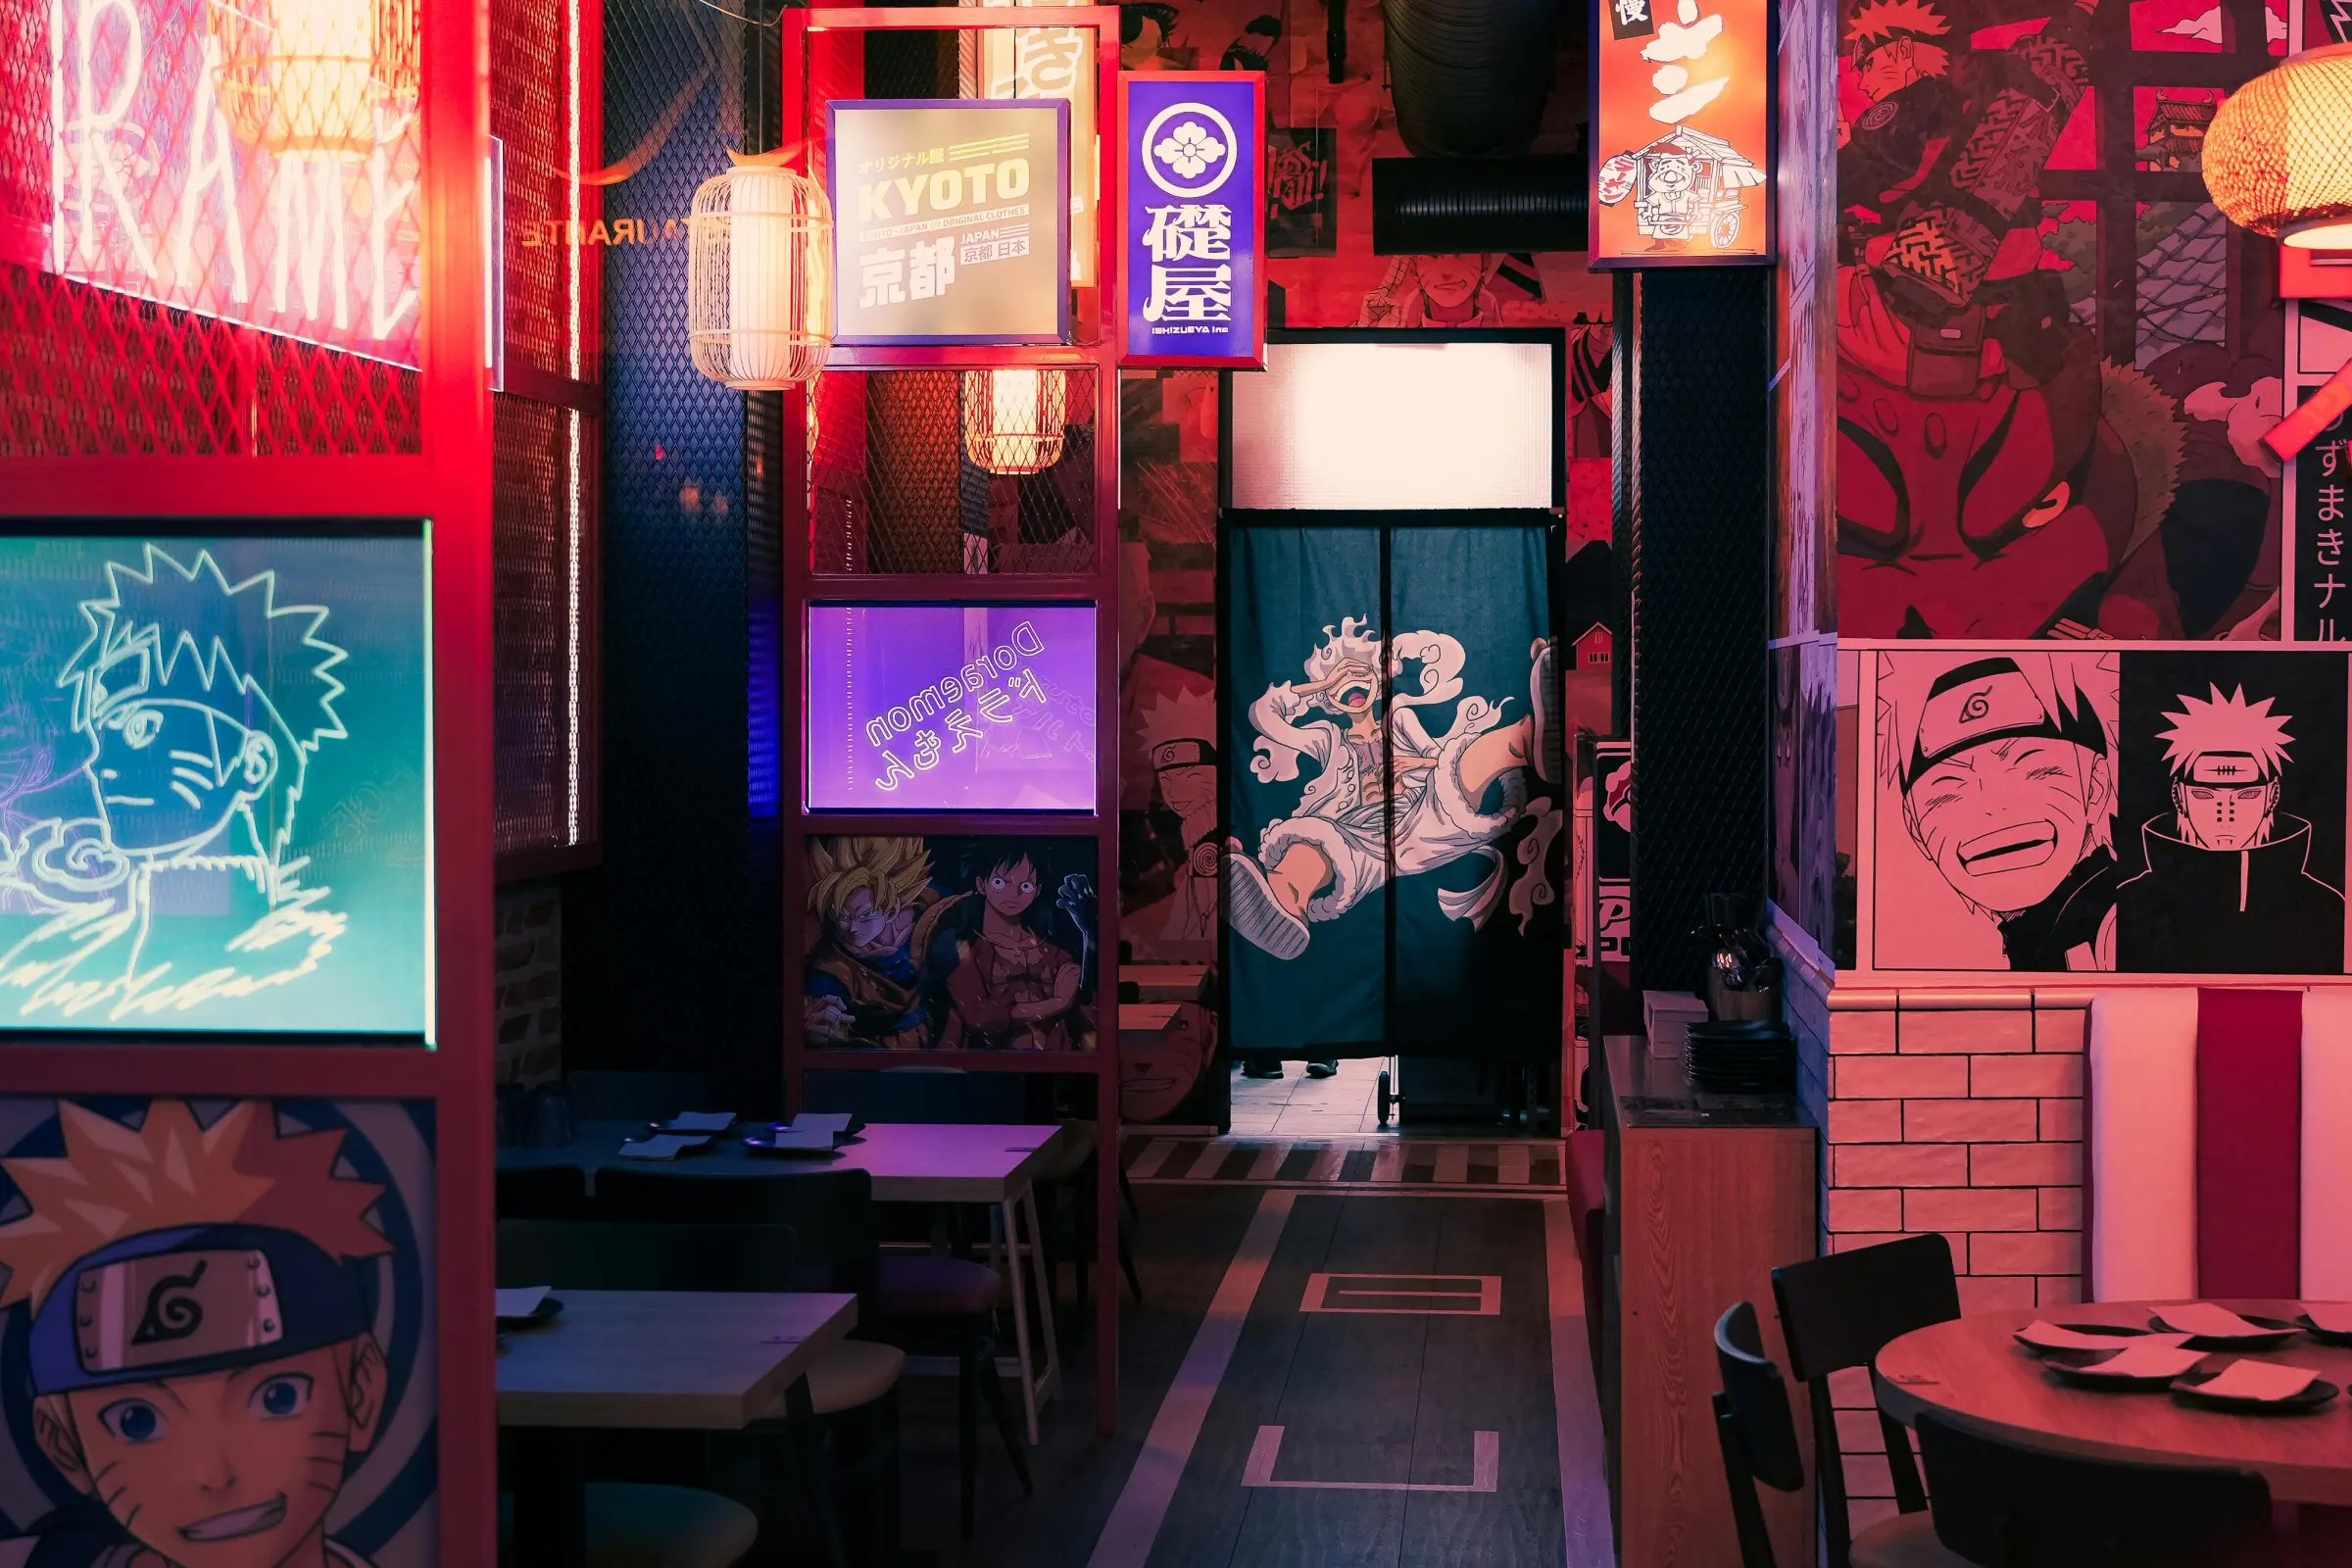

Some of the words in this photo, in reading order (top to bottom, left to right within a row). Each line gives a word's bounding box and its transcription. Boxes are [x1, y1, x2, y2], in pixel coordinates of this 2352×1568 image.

[858, 158, 1030, 224] KYOTO
[901, 222, 928, 234] JAPAN
[943, 214, 983, 227] ORIGINAL
[986, 207, 1025, 220] CLOTHES
[960, 228, 1000, 244] JAPAN
[963, 244, 993, 263] 京都
[998, 238, 1026, 257] 日本
[1142, 204, 1233, 322] 礎屋
[858, 236, 956, 309] 京都
[1152, 325, 1210, 335] ISHIZUEYA
